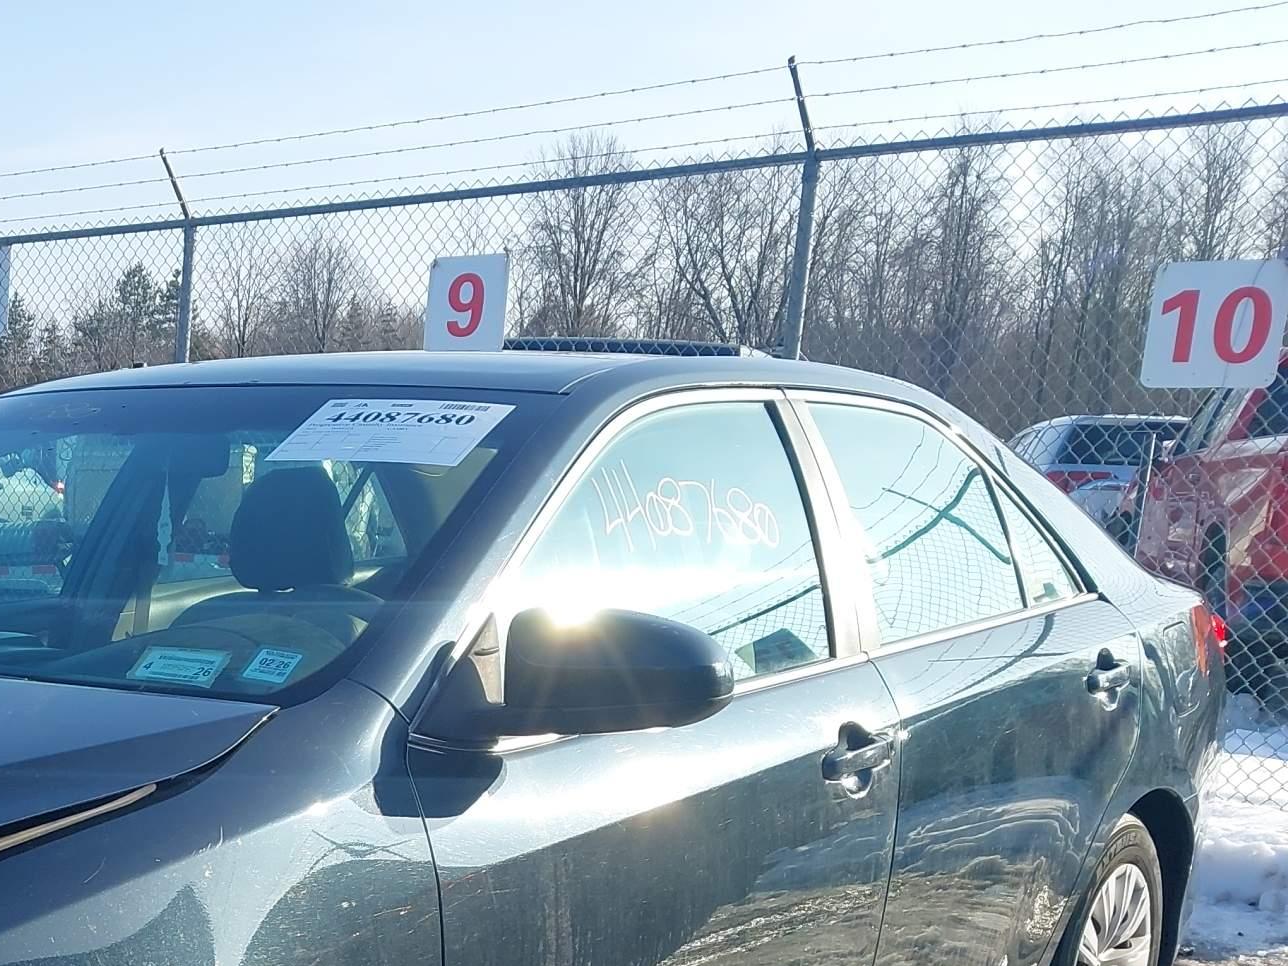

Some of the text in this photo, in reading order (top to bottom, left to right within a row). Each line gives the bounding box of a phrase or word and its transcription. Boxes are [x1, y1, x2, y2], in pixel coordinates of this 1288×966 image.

[446, 271, 485, 338] 9
[1160, 285, 1273, 365] 10
[325, 411, 476, 426] 44087680
[591, 459, 781, 552] 44087680
[143, 661, 154, 670] 4
[192, 666, 213, 677] 26
